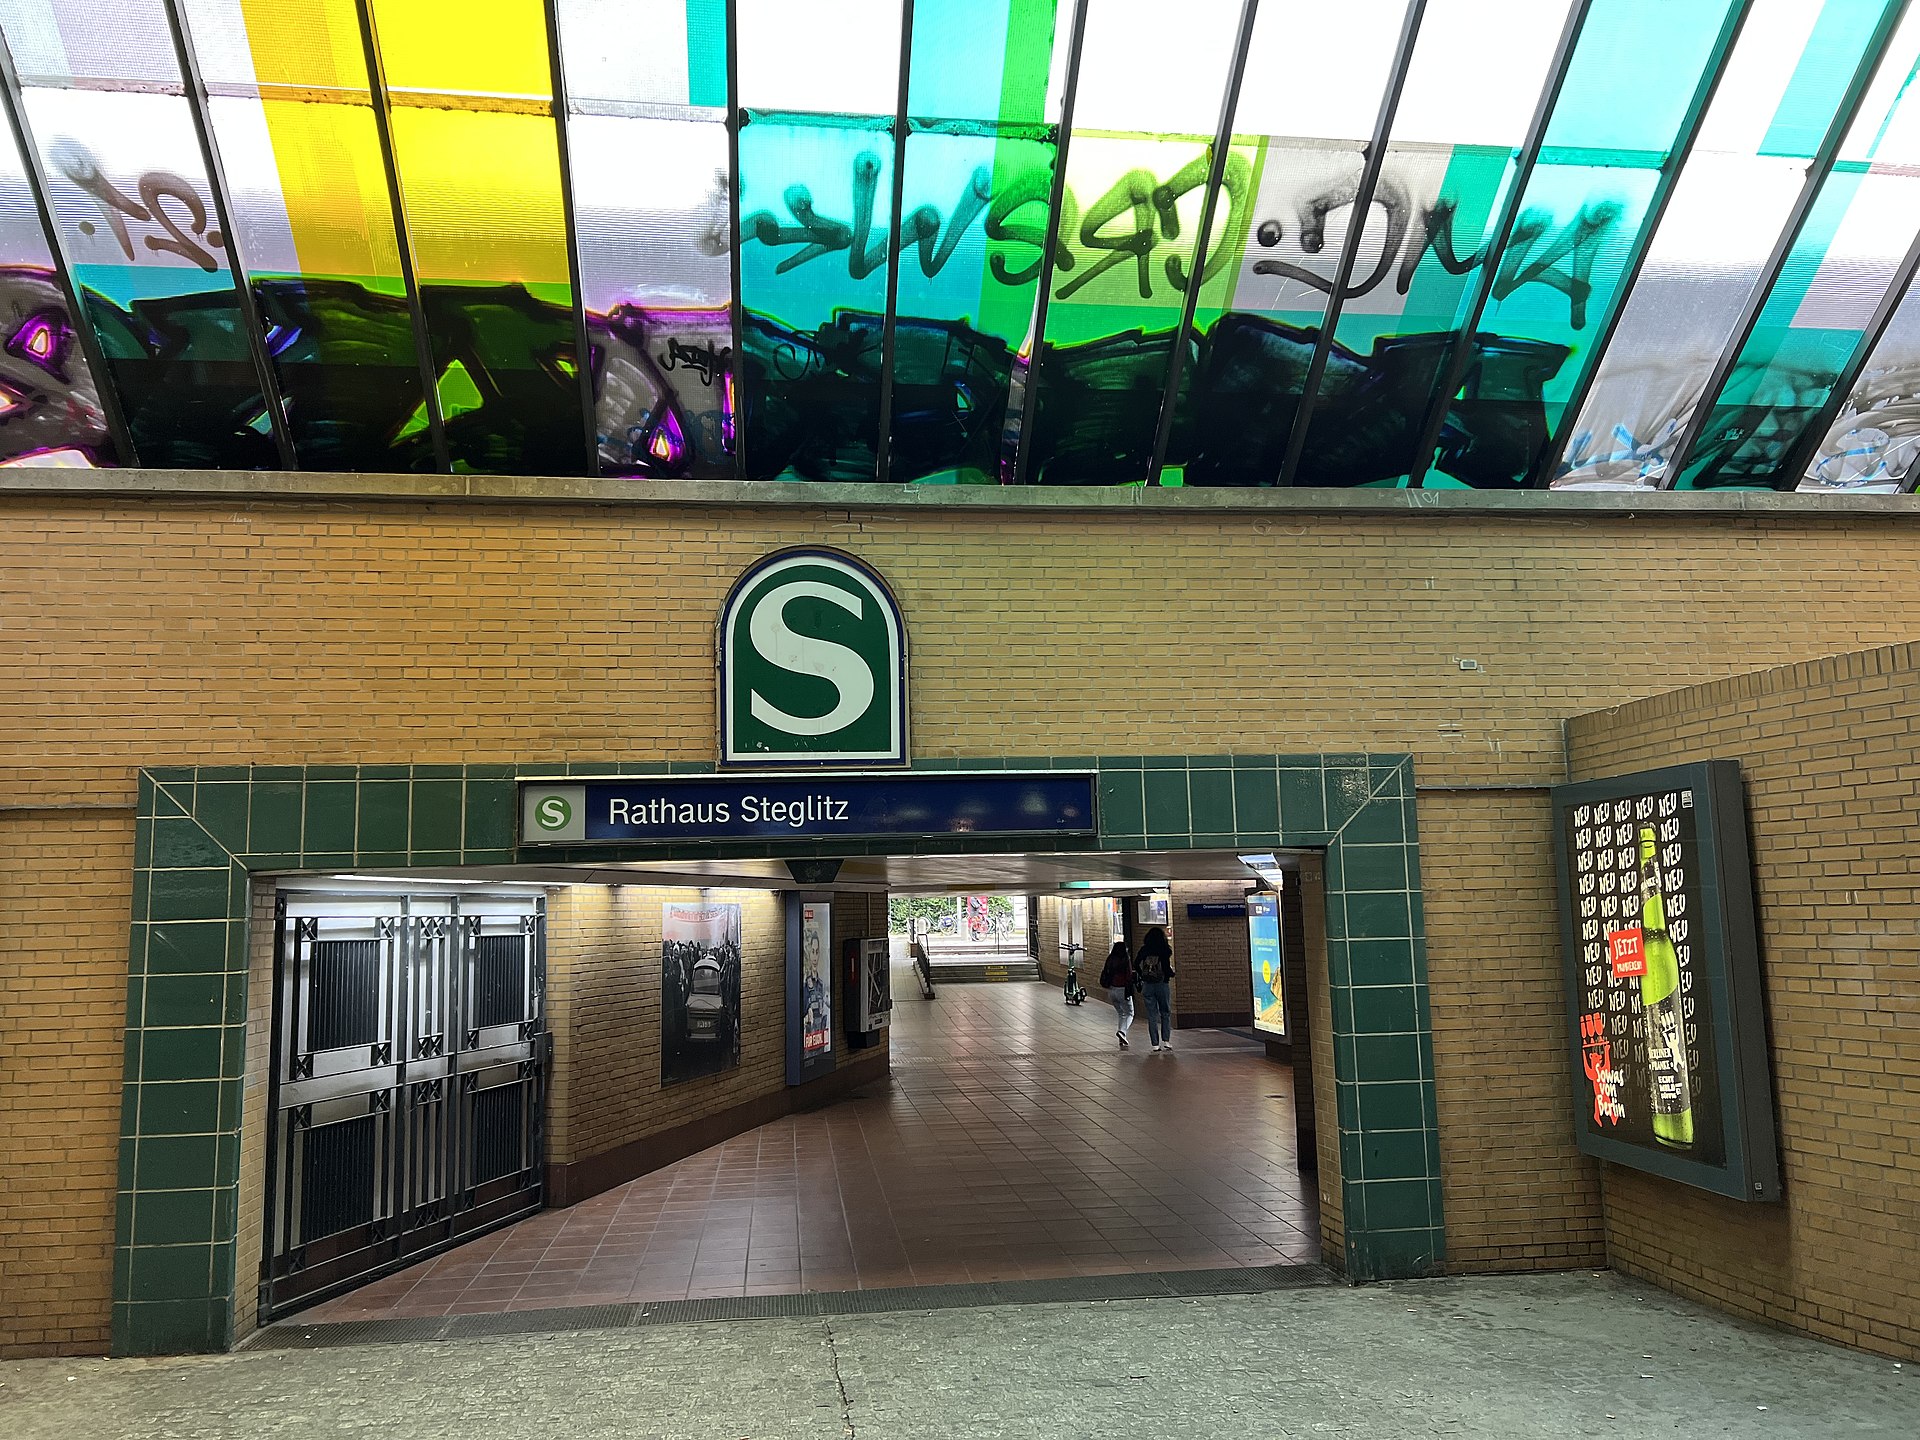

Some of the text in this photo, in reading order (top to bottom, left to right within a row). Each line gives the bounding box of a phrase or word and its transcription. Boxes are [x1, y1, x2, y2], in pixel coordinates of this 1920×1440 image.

[749, 580, 876, 736] S
[541, 794, 849, 828] S Rathaus Steglitz
[1574, 805, 1590, 827] NEU
[1594, 803, 1610, 824] NEU
[1614, 800, 1631, 822] NEU
[1636, 796, 1653, 820] NEU
[1658, 793, 1677, 817] NEU
[1576, 818, 1679, 849] NEU NEU NEU NEU
[1577, 843, 1681, 872] NEU NEU NEU NEU
[1579, 873, 1595, 894] NEU
[1599, 872, 1616, 894] NEU
[1620, 871, 1637, 893] NEU
[1665, 869, 1683, 892] NEU
[1581, 894, 1686, 917] NEU NEU NEU NEU
[1582, 919, 1598, 940] NEU
[1584, 942, 1600, 963] NEU
[1614, 937, 1638, 960] JETZT
[1677, 945, 1690, 967] EU
[1586, 966, 1602, 986] NEU
[1681, 971, 1692, 993] EU
[1587, 989, 1604, 1009] NEU
[1609, 991, 1626, 1011] NEU
[1683, 997, 1694, 1019] EU
[1611, 1015, 1627, 1035] NEU
[1685, 1023, 1697, 1045] EU
[1613, 1039, 1629, 1059] NEU
[1688, 1050, 1699, 1071] EU
[1596, 1063, 1624, 1087] Sowas
[1690, 1076, 1701, 1098] EU
[1599, 1083, 1617, 1098] von
[1597, 1095, 1625, 1118] Berlin
